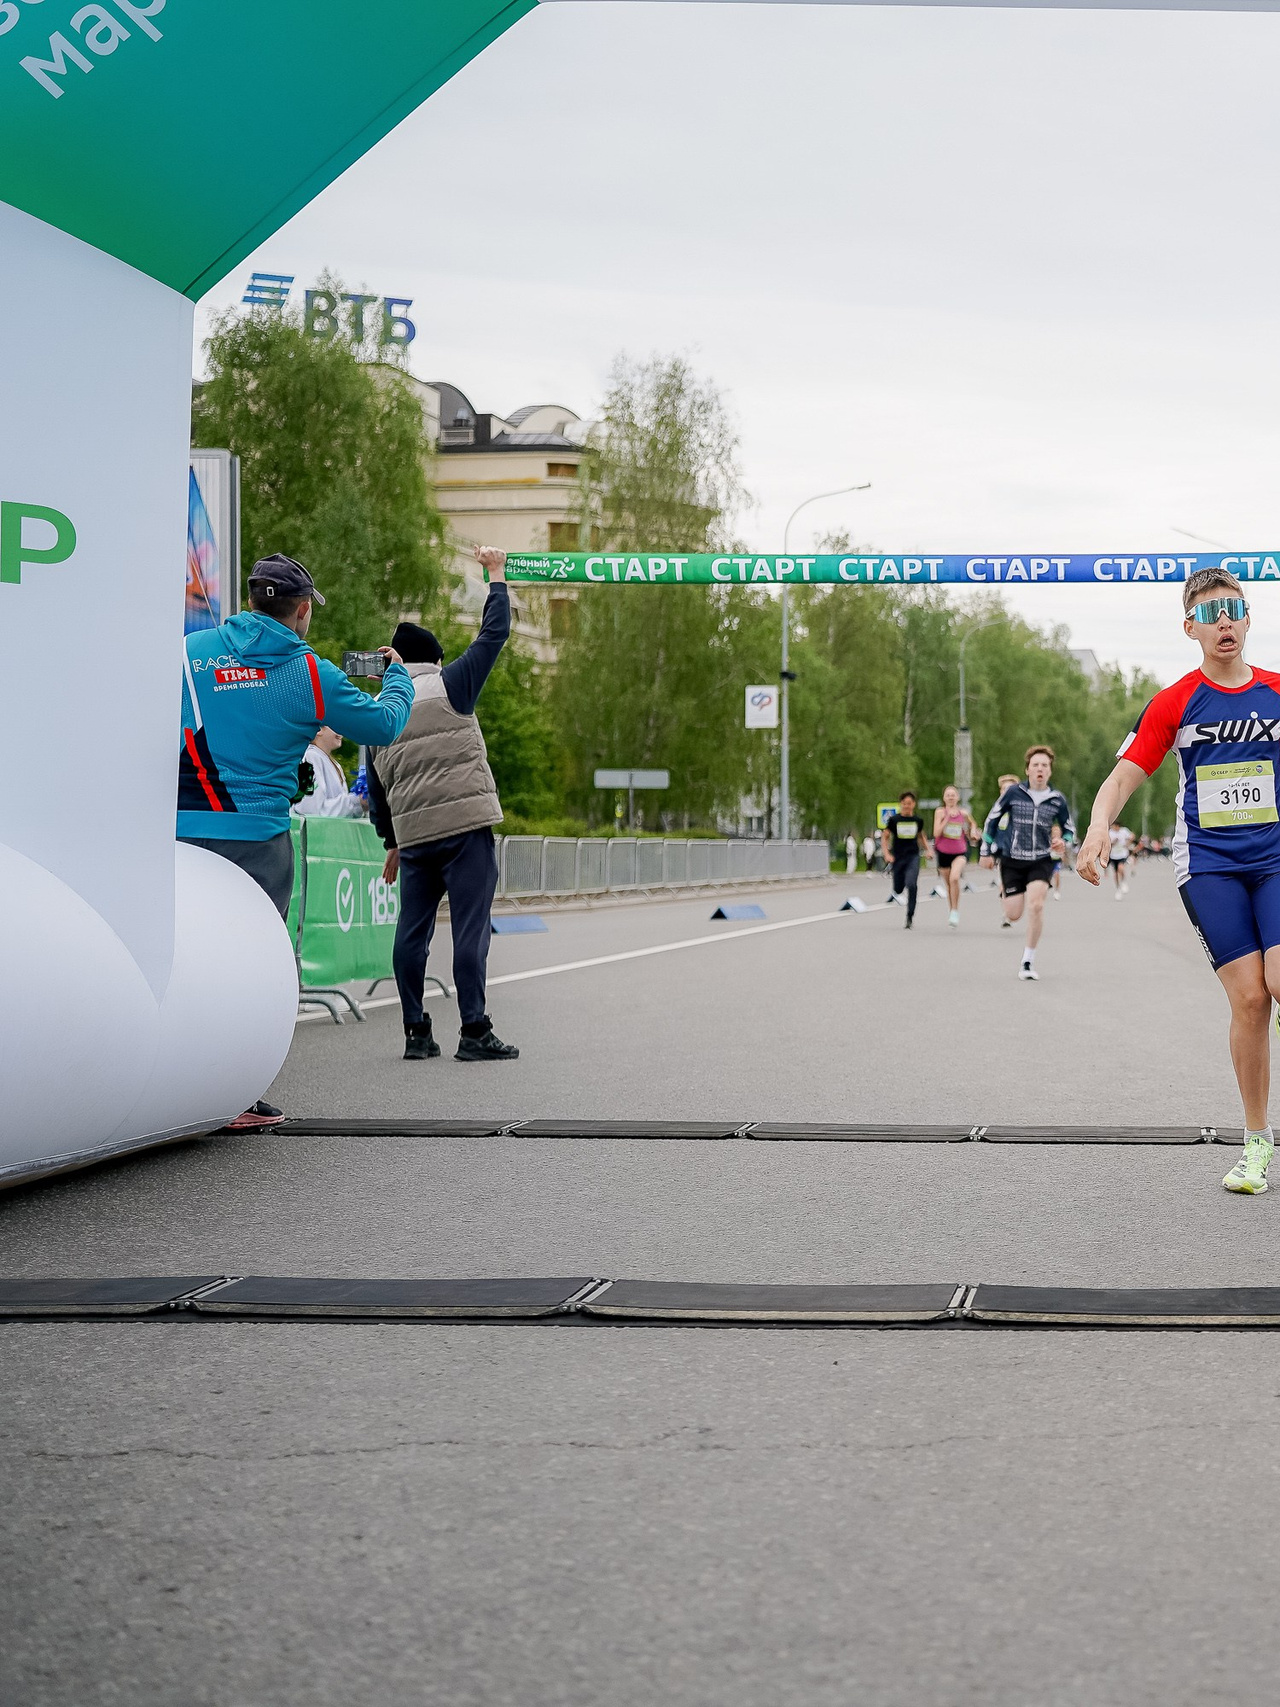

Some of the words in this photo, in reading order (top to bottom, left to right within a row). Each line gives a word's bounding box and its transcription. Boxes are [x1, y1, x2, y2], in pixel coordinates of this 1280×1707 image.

[304, 289, 416, 346] ВТБ
[504, 557, 551, 568] елёный
[585, 557, 689, 581] СТАРТ
[711, 557, 816, 581] СТАРТ
[838, 558, 944, 581] СТАРТ
[966, 558, 1071, 581] СТАРТ
[1093, 557, 1197, 581] СТАРТ
[192, 655, 241, 673] RACE
[221, 668, 259, 682] TIME
[1220, 787, 1261, 805] 3190
